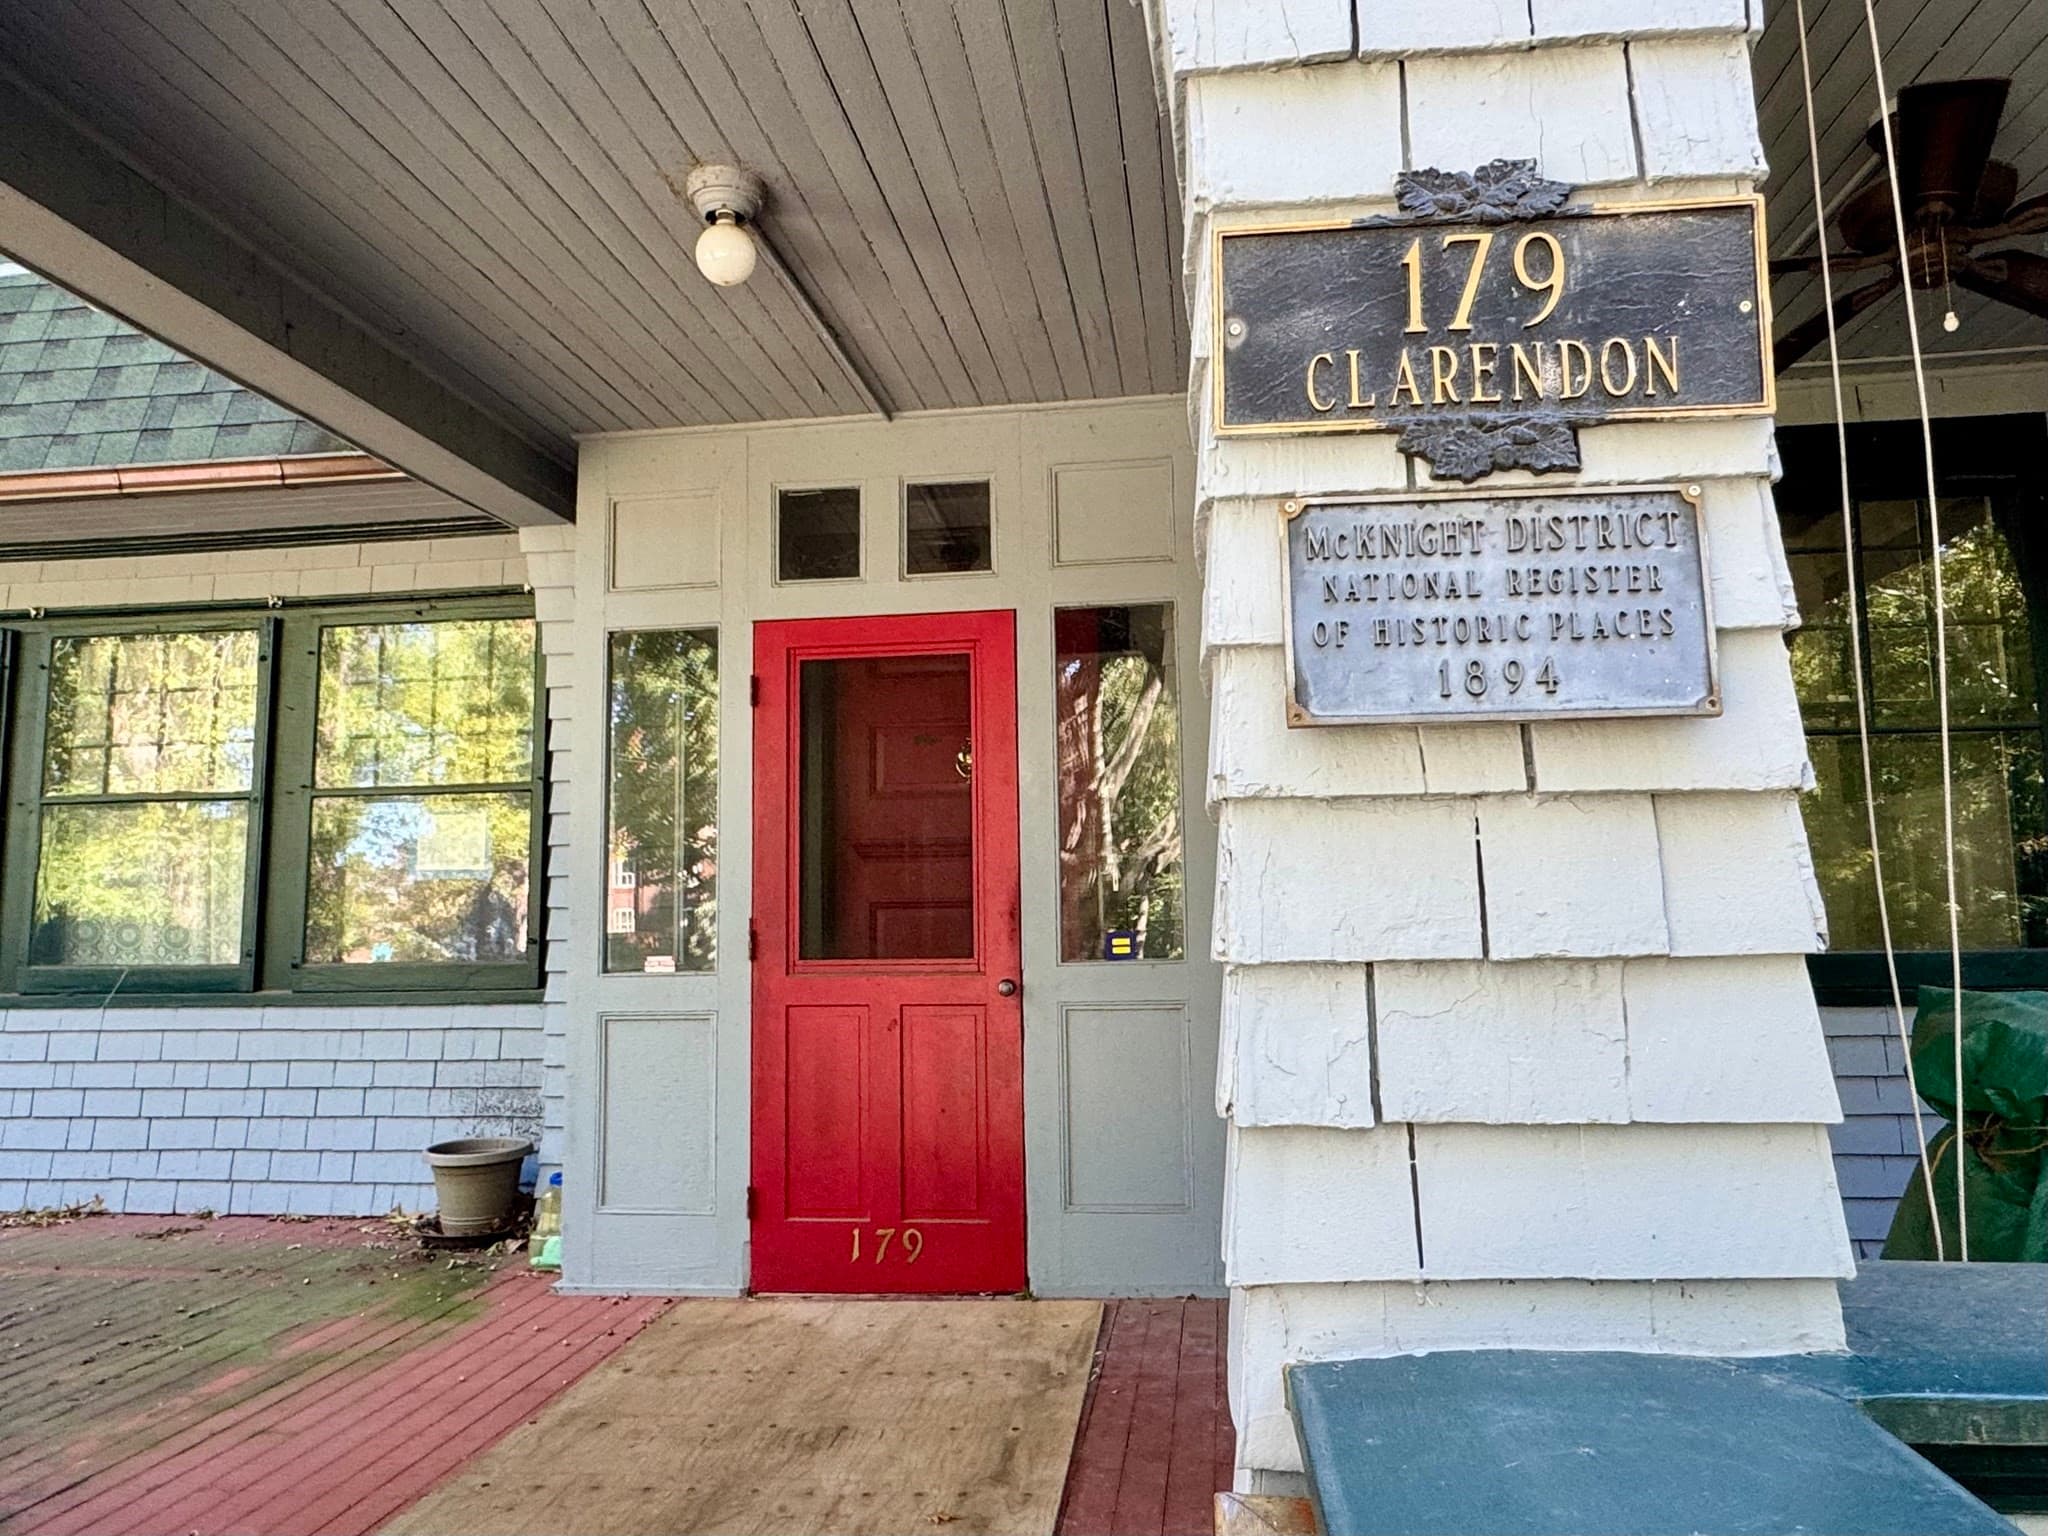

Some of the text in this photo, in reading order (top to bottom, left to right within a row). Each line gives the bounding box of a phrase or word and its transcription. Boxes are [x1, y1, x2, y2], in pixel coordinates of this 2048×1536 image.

[1401, 231, 1566, 334] 179
[1305, 335, 1680, 413] CLARENDON
[1506, 511, 1680, 553] DISTRICT
[1322, 564, 1665, 603] NATIONAL REGISTER
[1312, 607, 1677, 649] OF HISTORIC PLACES
[1437, 656, 1561, 698] 1894
[851, 1227, 923, 1265] 179
